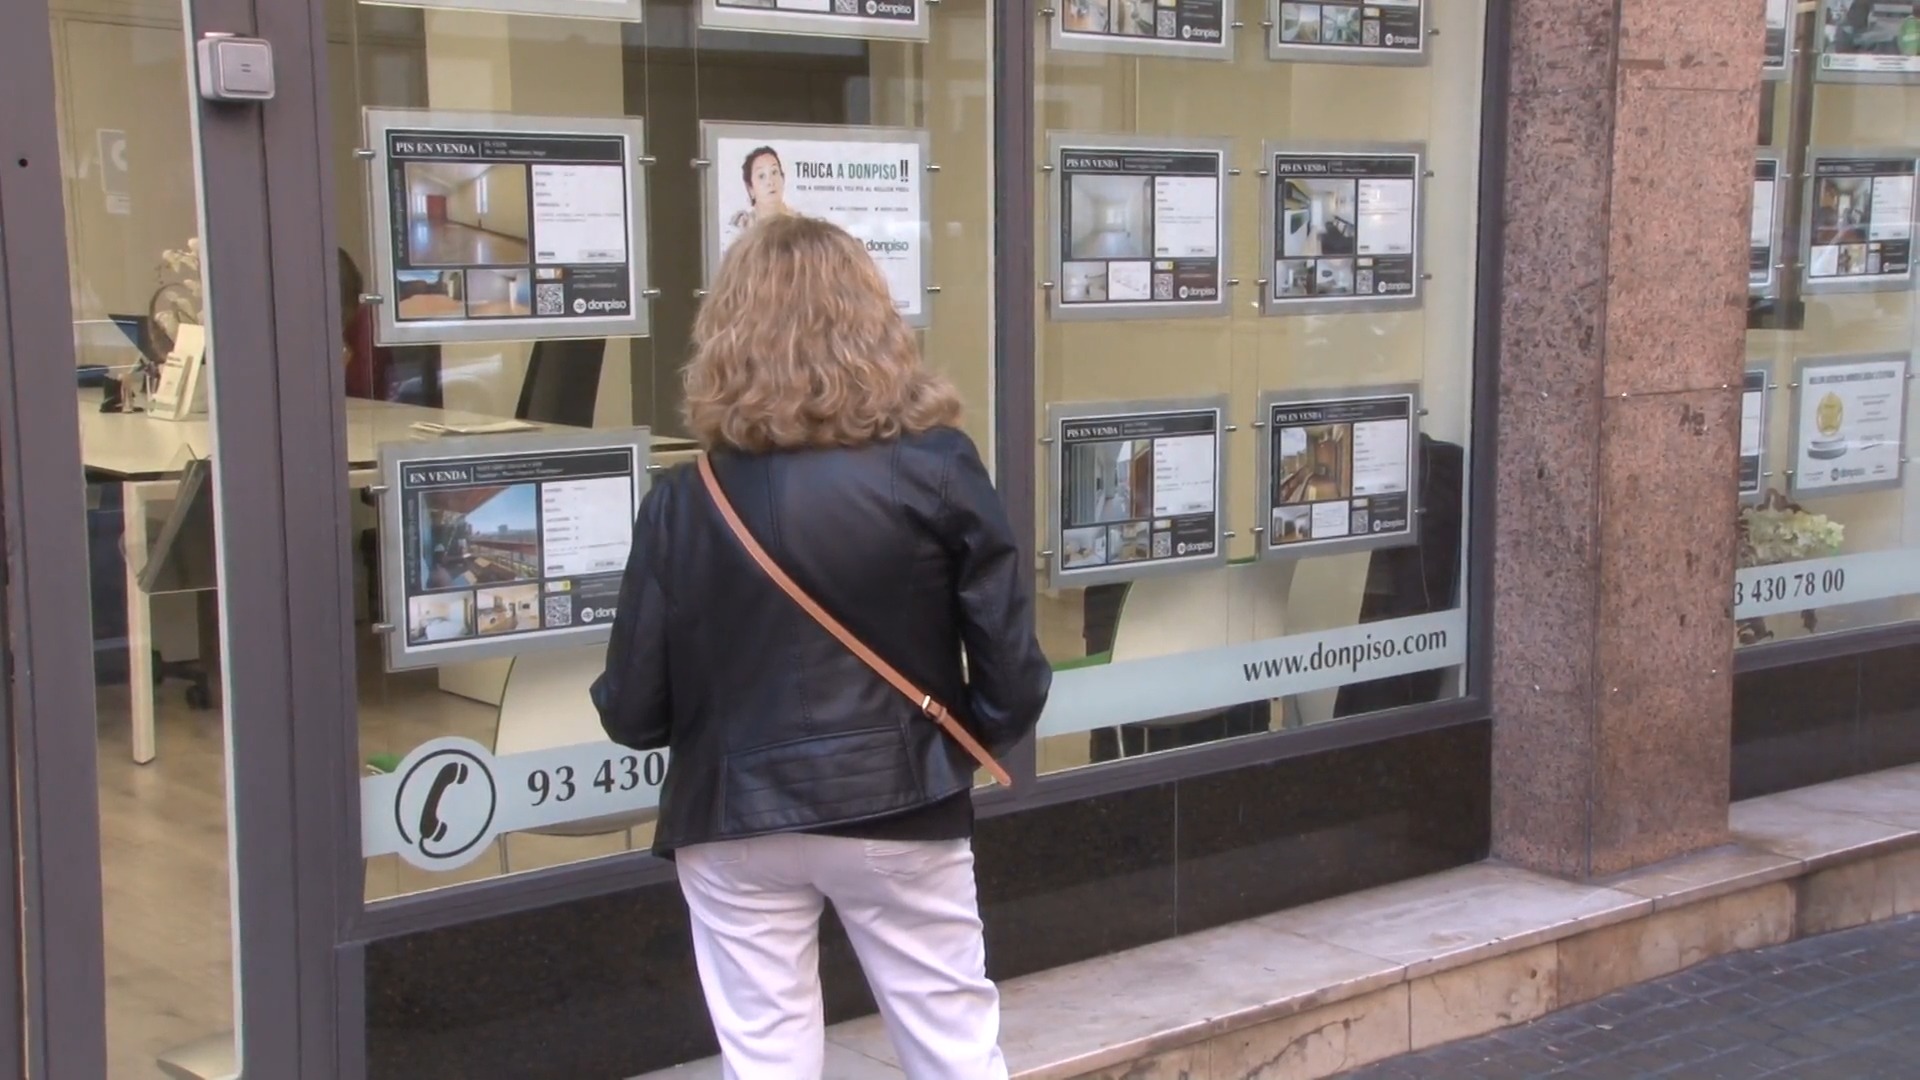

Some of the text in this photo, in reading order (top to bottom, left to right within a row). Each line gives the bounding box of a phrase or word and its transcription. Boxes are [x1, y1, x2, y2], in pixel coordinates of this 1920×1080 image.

[395, 142, 414, 154] PIS
[417, 143, 434, 154] EN
[435, 143, 476, 155] VENDA
[795, 161, 833, 179] TRUCA
[837, 164, 844, 179] A
[848, 163, 897, 180] DONPISO
[1066, 158, 1079, 168] PIS
[1080, 159, 1091, 168] EN
[1092, 159, 1119, 169] VENDA
[866, 239, 909, 254] donpiso
[587, 299, 627, 312] donpiso
[1066, 427, 1079, 438] PIS
[1080, 426, 1092, 437] EN
[1092, 425, 1119, 436] VENDA
[409, 470, 468, 484] EN VENDA
[1751, 576, 1786, 602] 430
[1794, 571, 1815, 597] 78
[1822, 568, 1845, 593] 00
[1243, 629, 1447, 682] www.donpiso.com
[527, 751, 666, 806] 93 430
